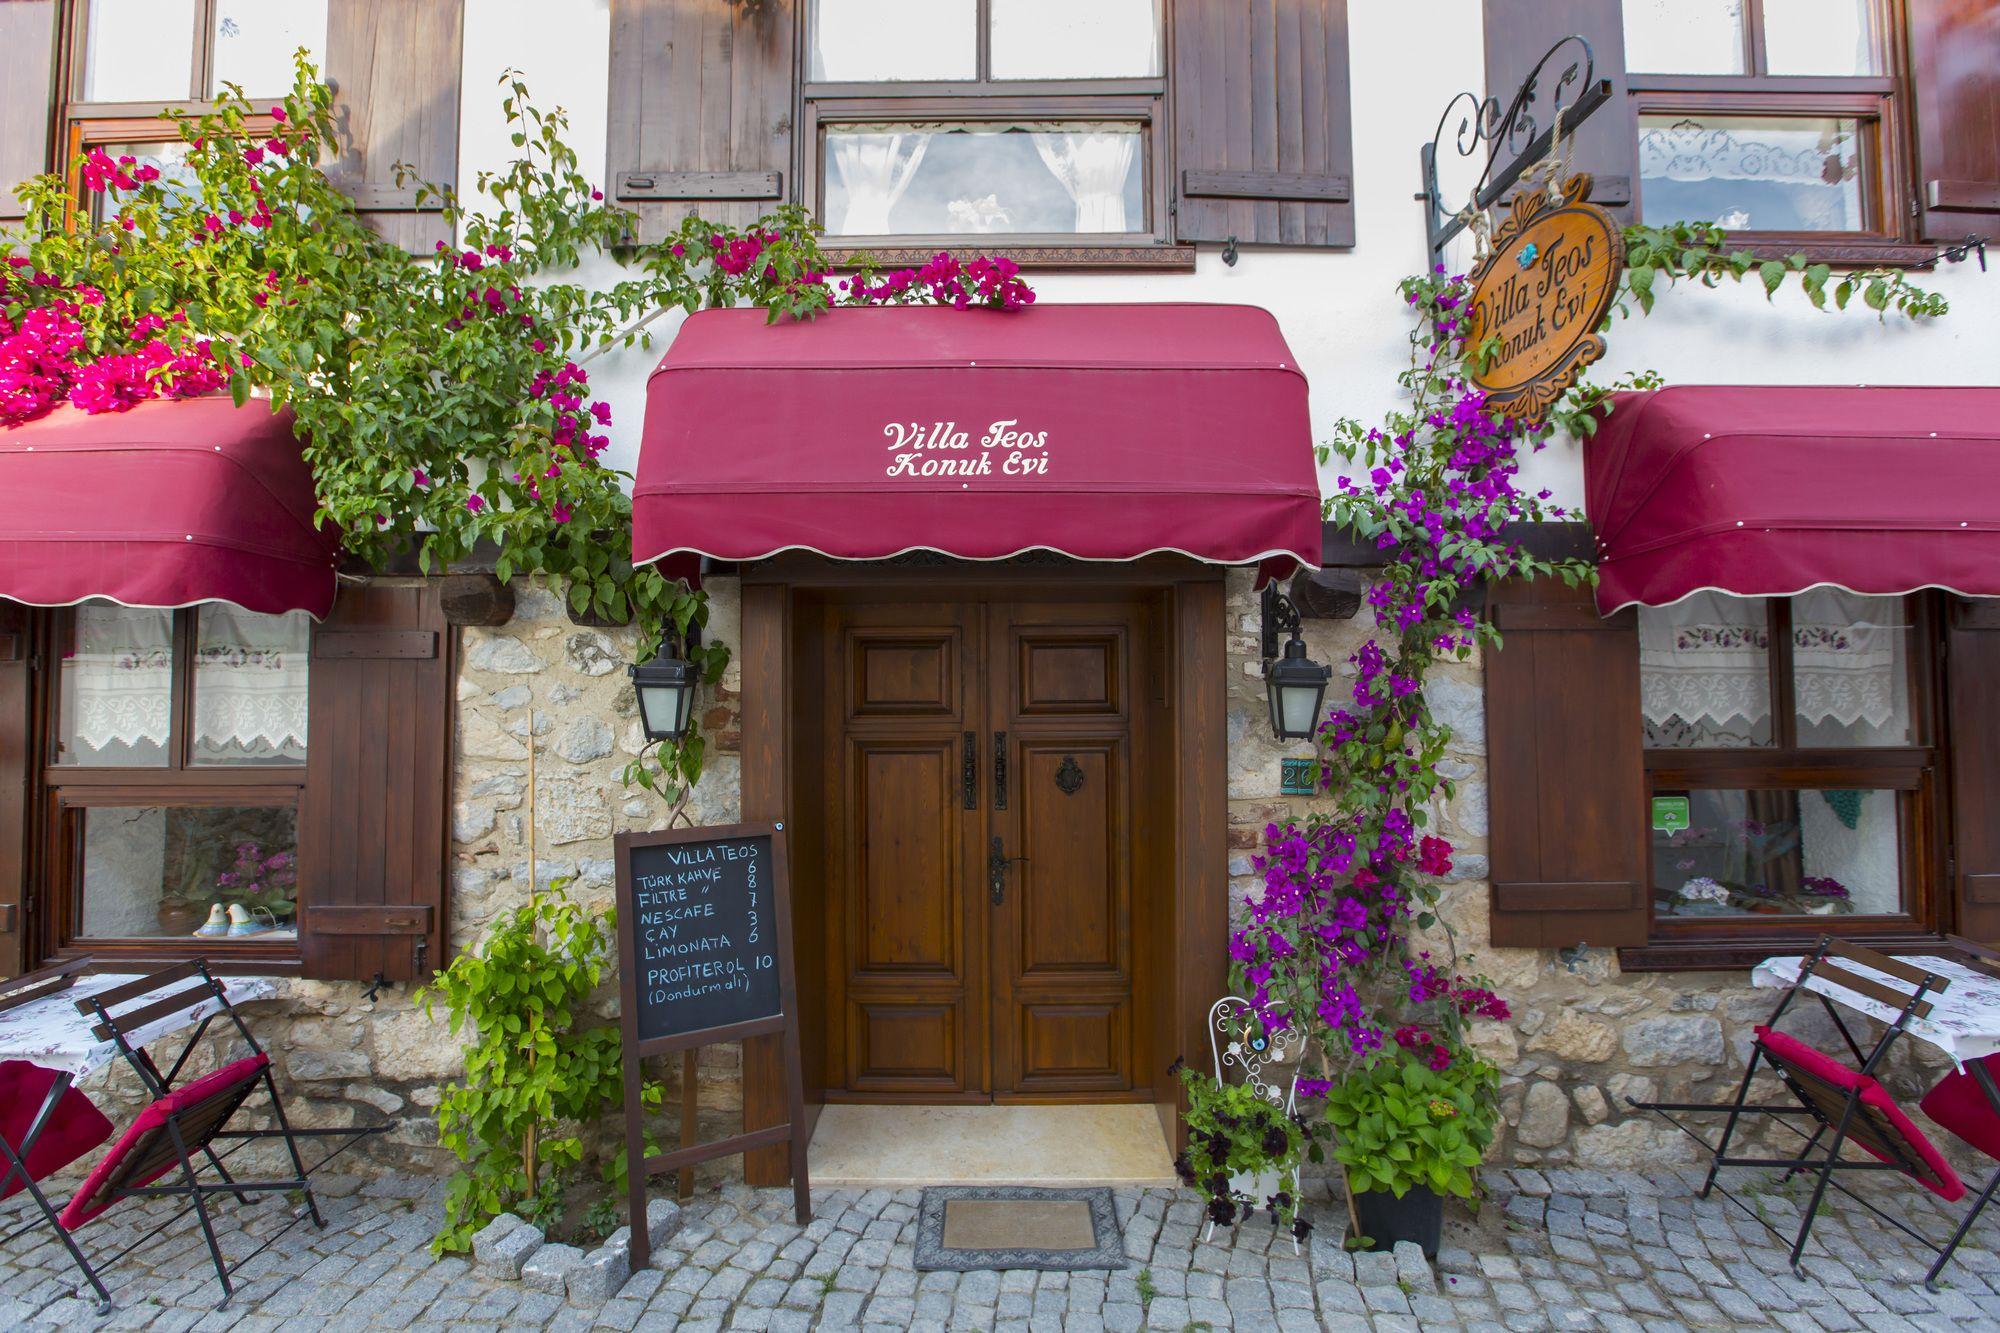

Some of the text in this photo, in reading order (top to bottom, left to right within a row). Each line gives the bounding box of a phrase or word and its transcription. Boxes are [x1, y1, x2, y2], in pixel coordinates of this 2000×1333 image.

[1474, 232, 1595, 342] Villa Teos
[1551, 282, 1587, 332] Evi
[884, 419, 1048, 450] Villa Teos
[886, 451, 1049, 476] Konuk Evi
[716, 844, 758, 861] TEOS
[637, 860, 757, 890] TÜRK KAHVE 6
[747, 874, 757, 888] 8
[640, 891, 757, 925] NESCAFE 7
[645, 910, 758, 942] ÇAY 3
[748, 926, 759, 943] 6
[755, 955, 772, 970] 10
